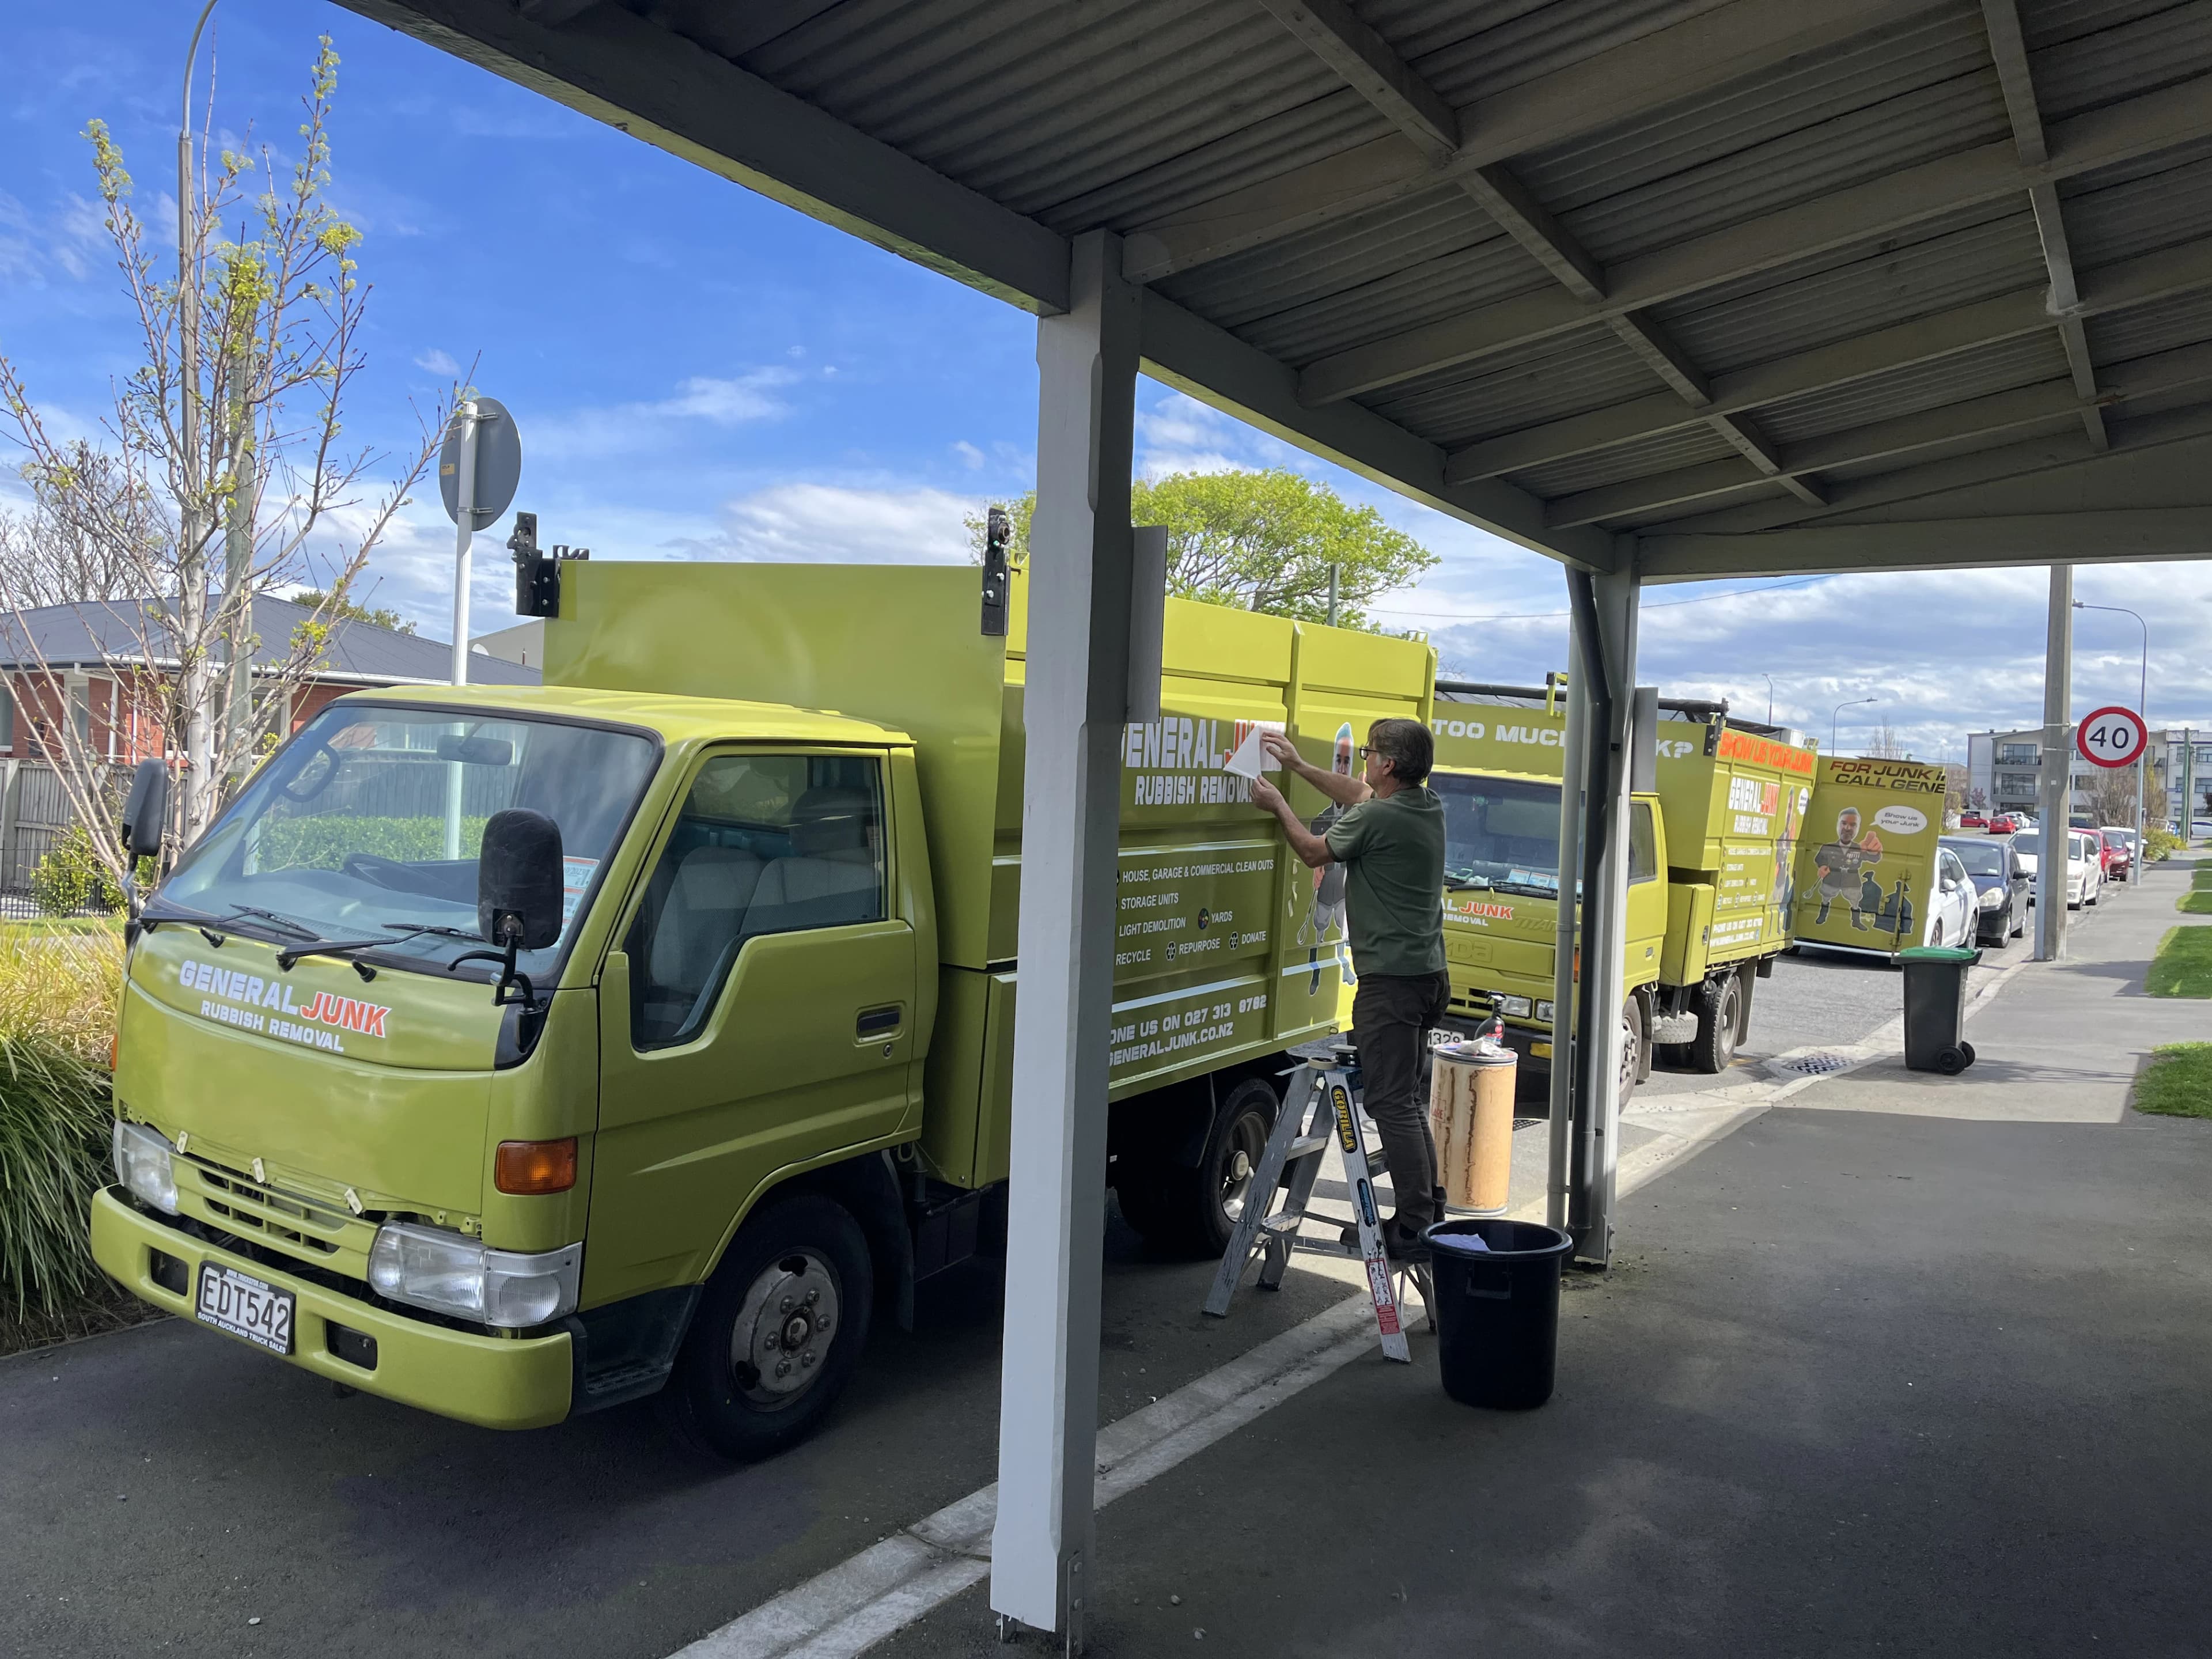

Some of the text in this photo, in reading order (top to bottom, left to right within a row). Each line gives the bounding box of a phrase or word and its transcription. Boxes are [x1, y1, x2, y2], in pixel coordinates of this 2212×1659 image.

[1431, 718, 1484, 739] TOO
[2089, 726, 2129, 749] 40
[1121, 717, 1223, 768] ENERAL
[1830, 760, 1872, 774] FOR
[1874, 766, 1934, 780] JUNK
[1135, 776, 1196, 805] RUBBISH
[1835, 774, 1946, 794] CALL GENE
[1123, 859, 1274, 883] HOUSE, GARAGE & COMMERCIAL CLEAN OUTS
[1121, 892, 1179, 910] STORAGE UNITS
[1459, 901, 1514, 920] JUNK
[1119, 916, 1186, 937] LIGHT DEMOLITION
[1211, 910, 1233, 924] YARDS
[1179, 938, 1221, 955] REPURPOSE
[1241, 930, 1267, 944] DONATE
[1116, 949, 1151, 966] RECYCLE
[179, 960, 392, 1038] GENERAL JUNK
[201, 1000, 344, 1052] RUBBISH REMOVAL
[1110, 1025, 1135, 1045] ONE
[1140, 1020, 1158, 1037] US
[1162, 1014, 1181, 1032] ON
[1184, 1007, 1209, 1027] 027
[1213, 1002, 1231, 1020] 313
[1109, 1022, 1234, 1067] ENERALJUNK.CO.NZ
[1333, 1089, 1355, 1151] GORILLA
[202, 1274, 289, 1342] EDT542
[198, 1312, 286, 1354] SOUTH AUCKLAND TRUCK SALES
